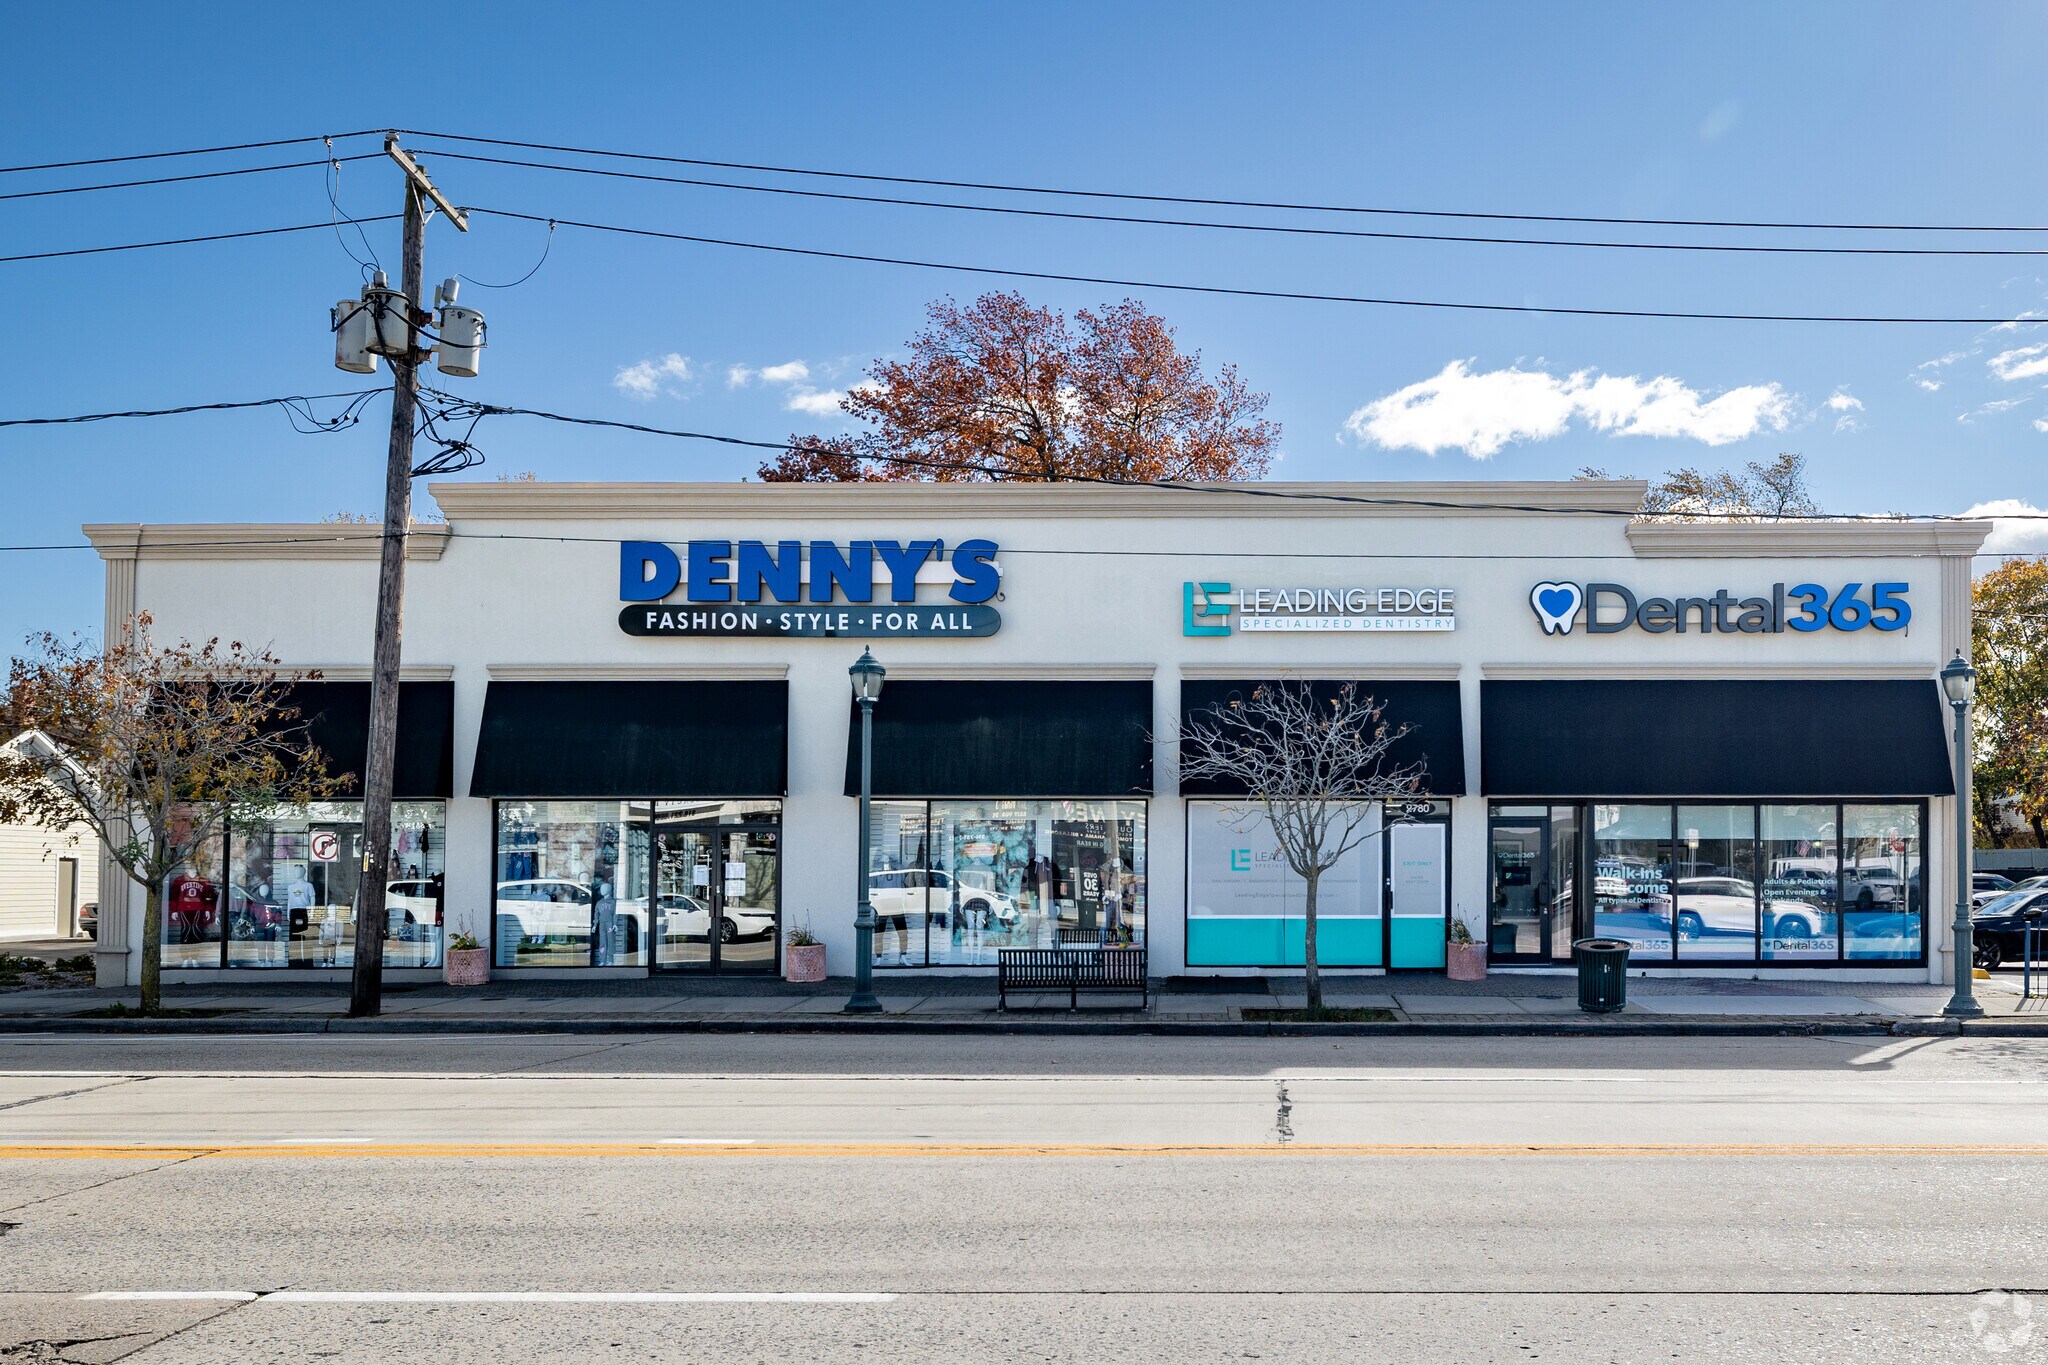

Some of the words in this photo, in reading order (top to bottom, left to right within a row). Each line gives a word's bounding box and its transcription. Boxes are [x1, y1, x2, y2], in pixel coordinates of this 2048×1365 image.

[620, 538, 1000, 604] DENNY'S
[1240, 588, 1367, 614] LEADING
[1377, 588, 1454, 614] EDGE
[1586, 582, 1912, 634] Dental365
[646, 612, 758, 630] FASHION
[780, 612, 849, 630] STYLE
[872, 612, 920, 630] FOR
[930, 612, 973, 630] ALL
[1243, 618, 1352, 628] SPECIALIZED
[1363, 618, 1453, 628] DENTISTRY
[1774, 940, 1834, 950] Dental365
